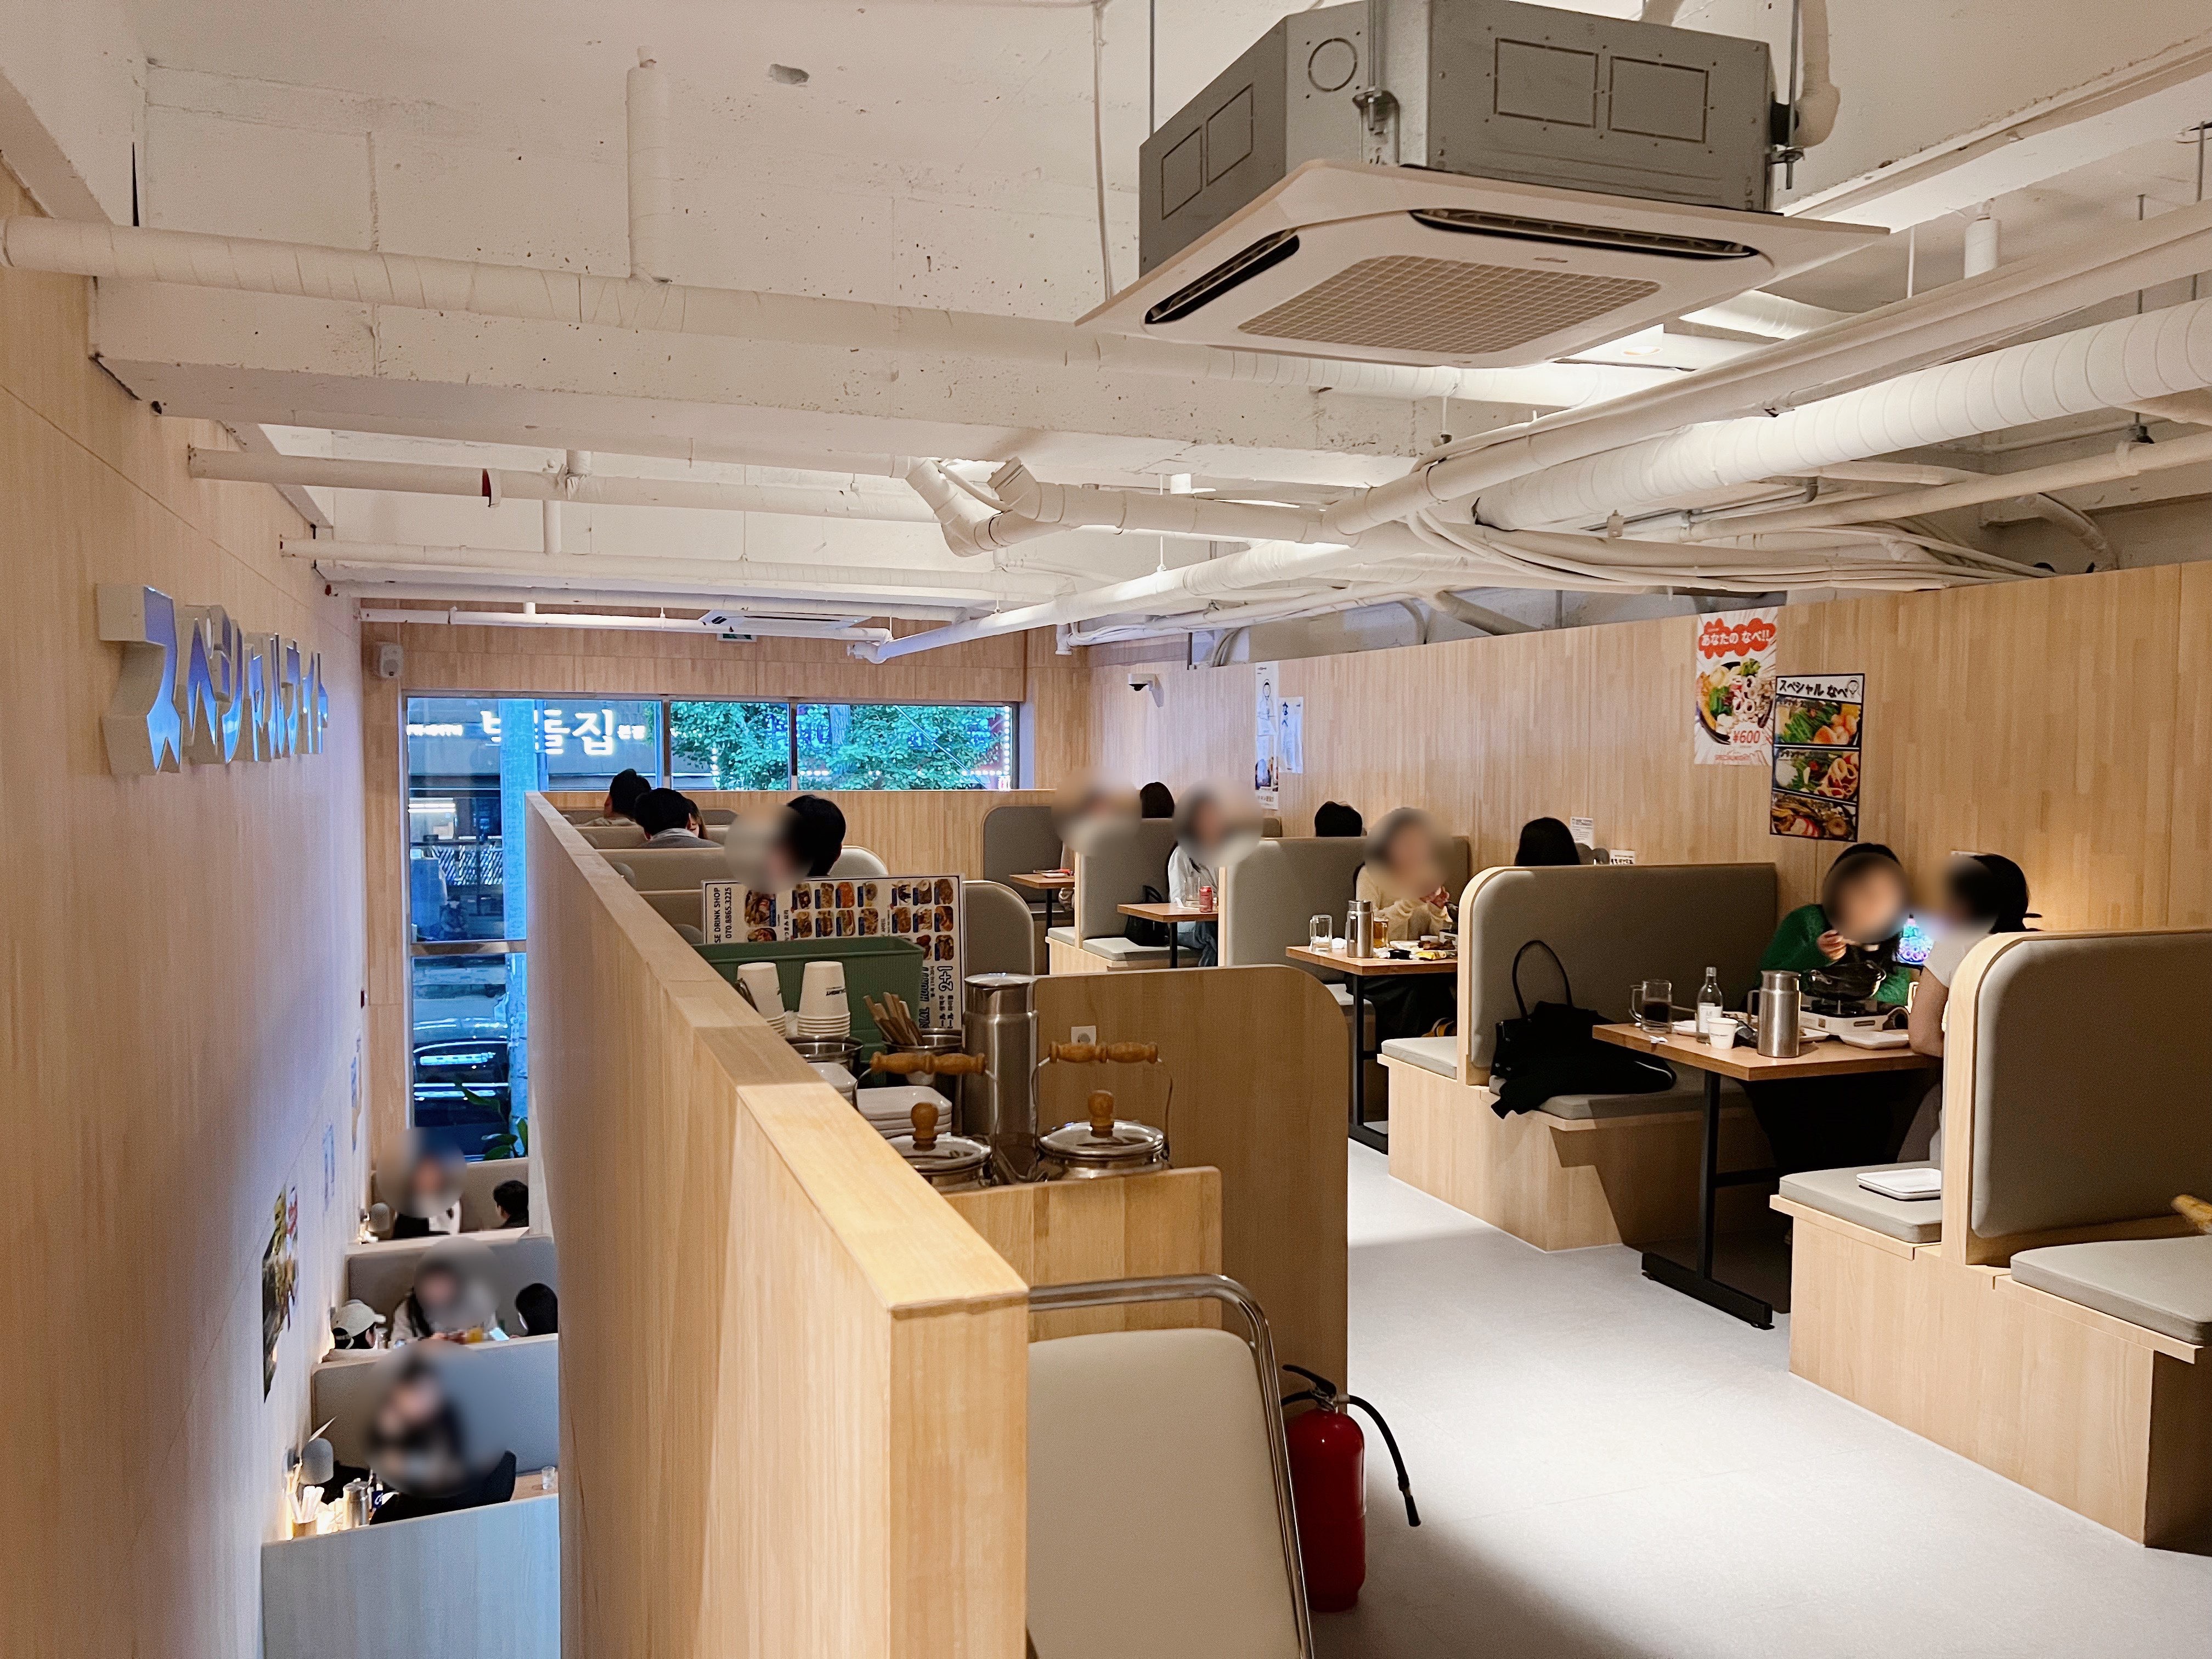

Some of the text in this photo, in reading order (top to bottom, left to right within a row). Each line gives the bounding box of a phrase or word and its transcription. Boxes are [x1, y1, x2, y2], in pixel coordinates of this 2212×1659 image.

[1701, 632, 1740, 647] あなたの
[1779, 680, 1825, 696] スペシャル
[1732, 730, 1761, 744] ¥600
[936, 966, 954, 992] 2+1
